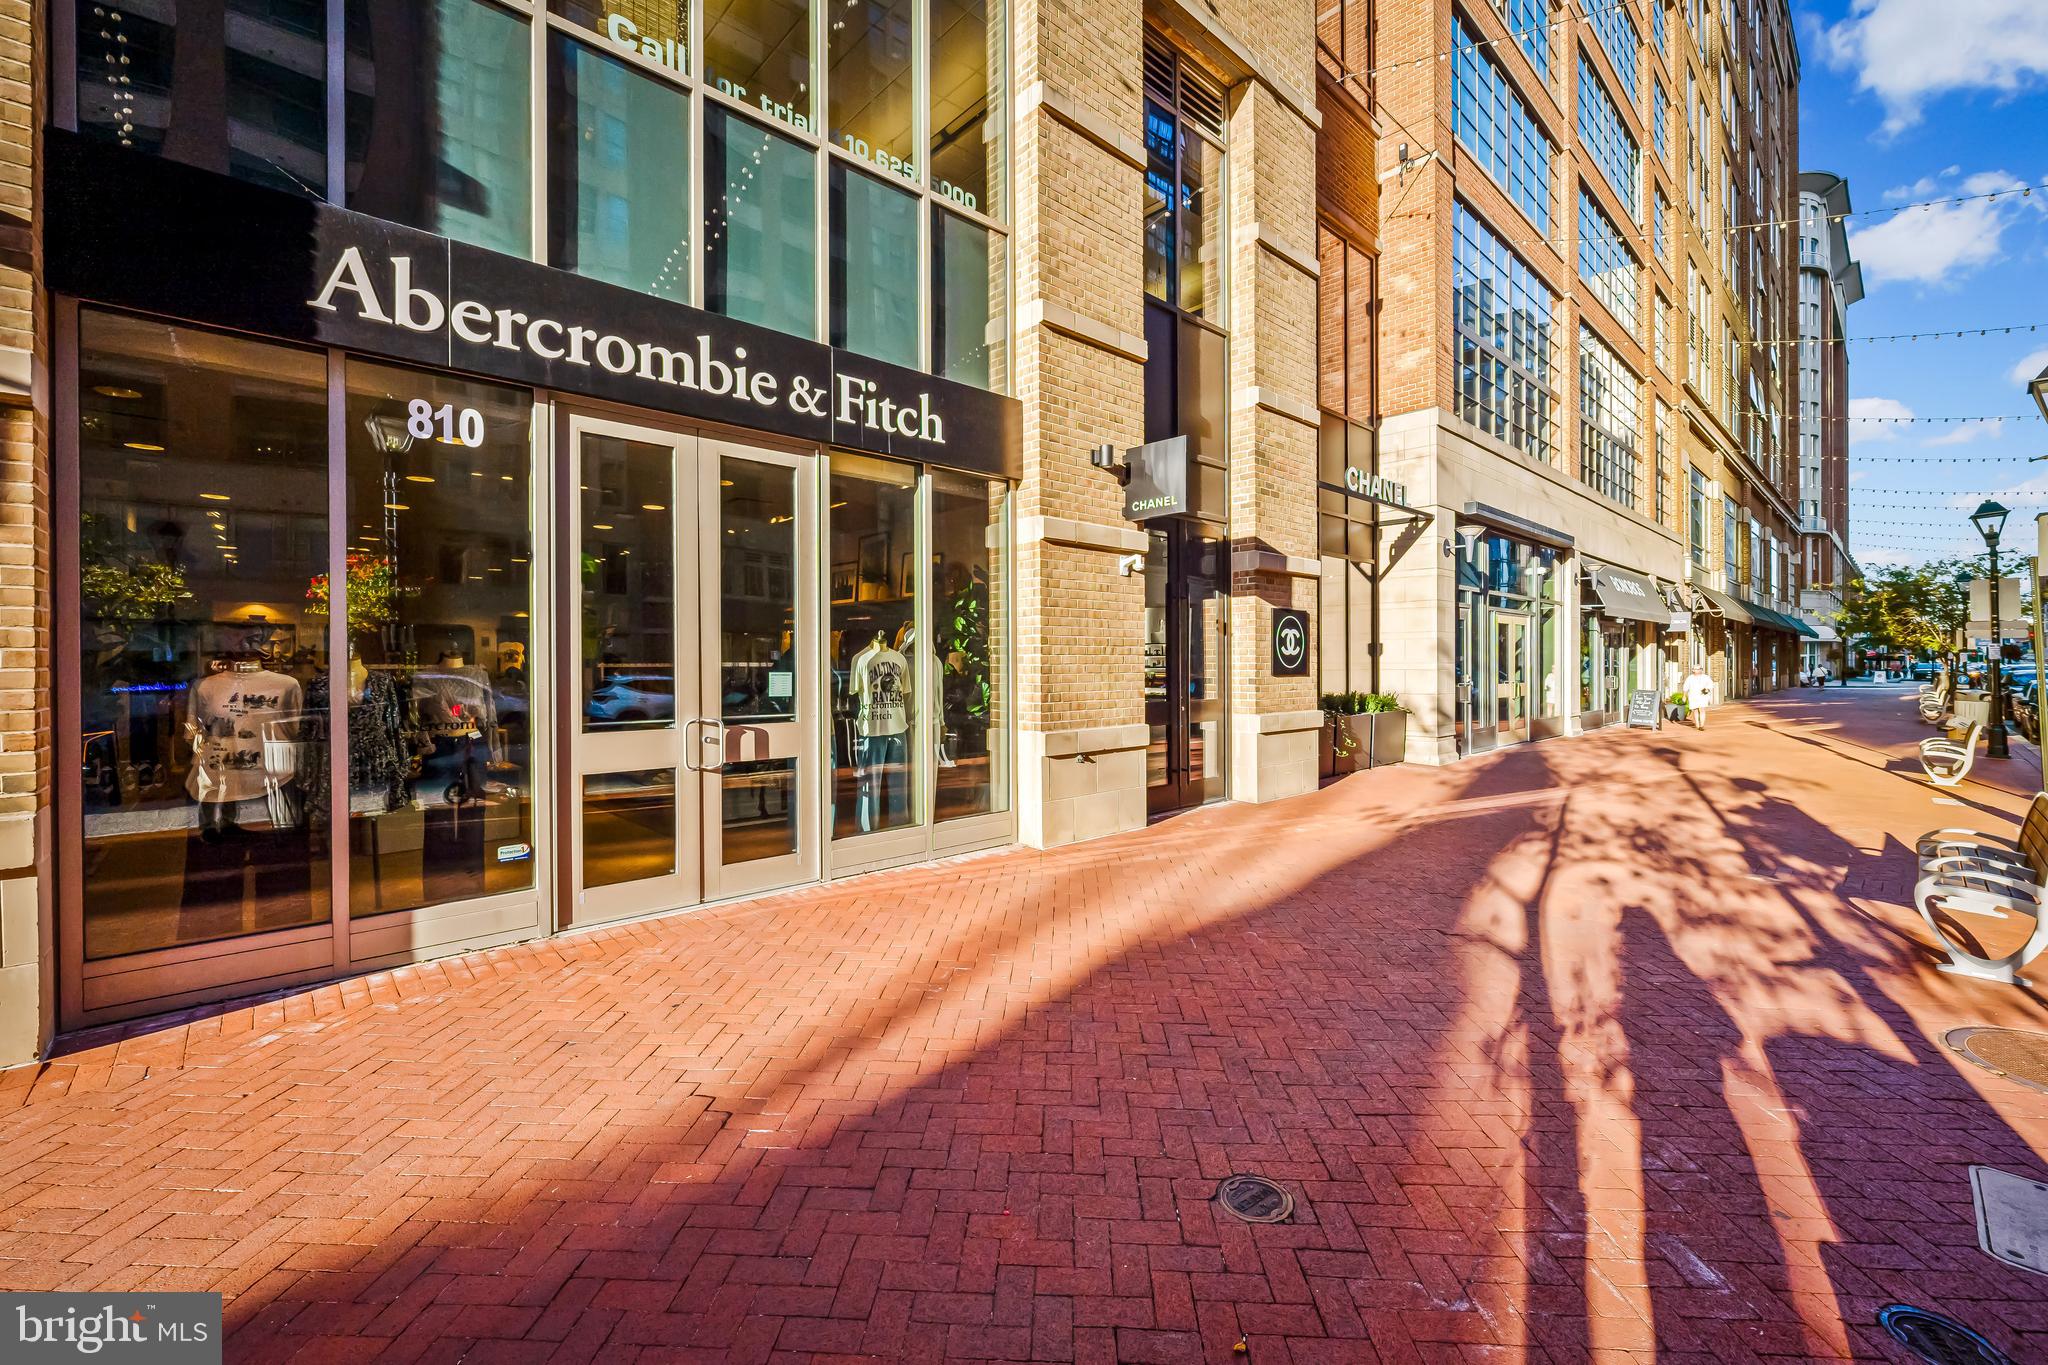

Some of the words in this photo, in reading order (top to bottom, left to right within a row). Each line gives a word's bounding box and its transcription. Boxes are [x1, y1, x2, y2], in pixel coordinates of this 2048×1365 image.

[608, 13, 686, 75] Call
[760, 93, 818, 136] trial
[307, 246, 778, 407] Abercrombie
[788, 375, 828, 418] &
[836, 372, 946, 444] Fitch
[407, 398, 485, 448] 810
[1131, 495, 1178, 511] CHANEL
[1345, 466, 1412, 508] CHANEL
